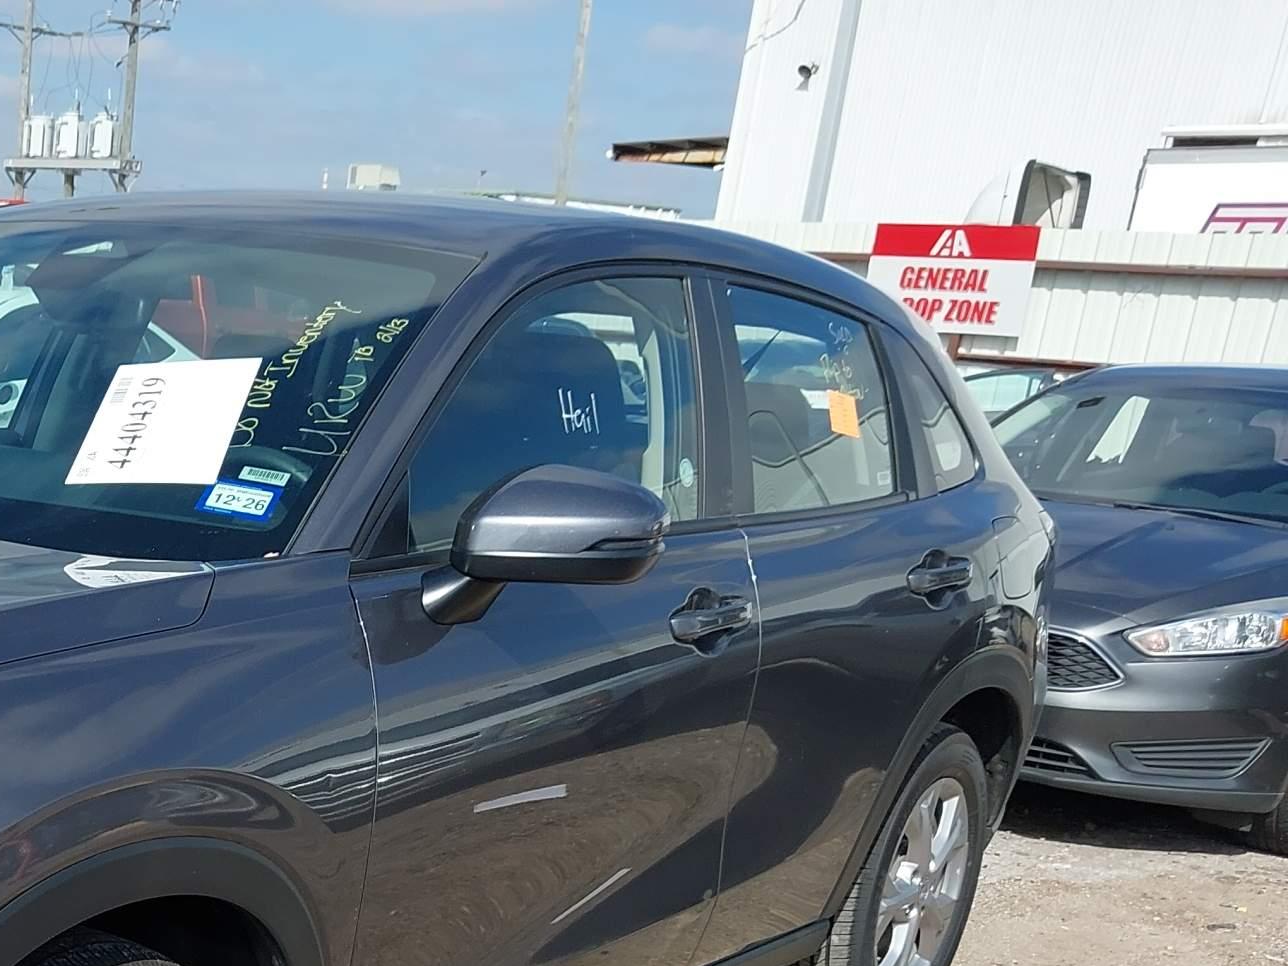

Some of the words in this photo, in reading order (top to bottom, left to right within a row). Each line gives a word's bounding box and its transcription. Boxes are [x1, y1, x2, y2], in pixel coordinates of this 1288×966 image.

[899, 265, 991, 293] GENERAL
[944, 299, 1001, 326] ZONE
[264, 300, 362, 378] Inventory
[106, 377, 167, 469] 44404319
[557, 387, 600, 435] Hail
